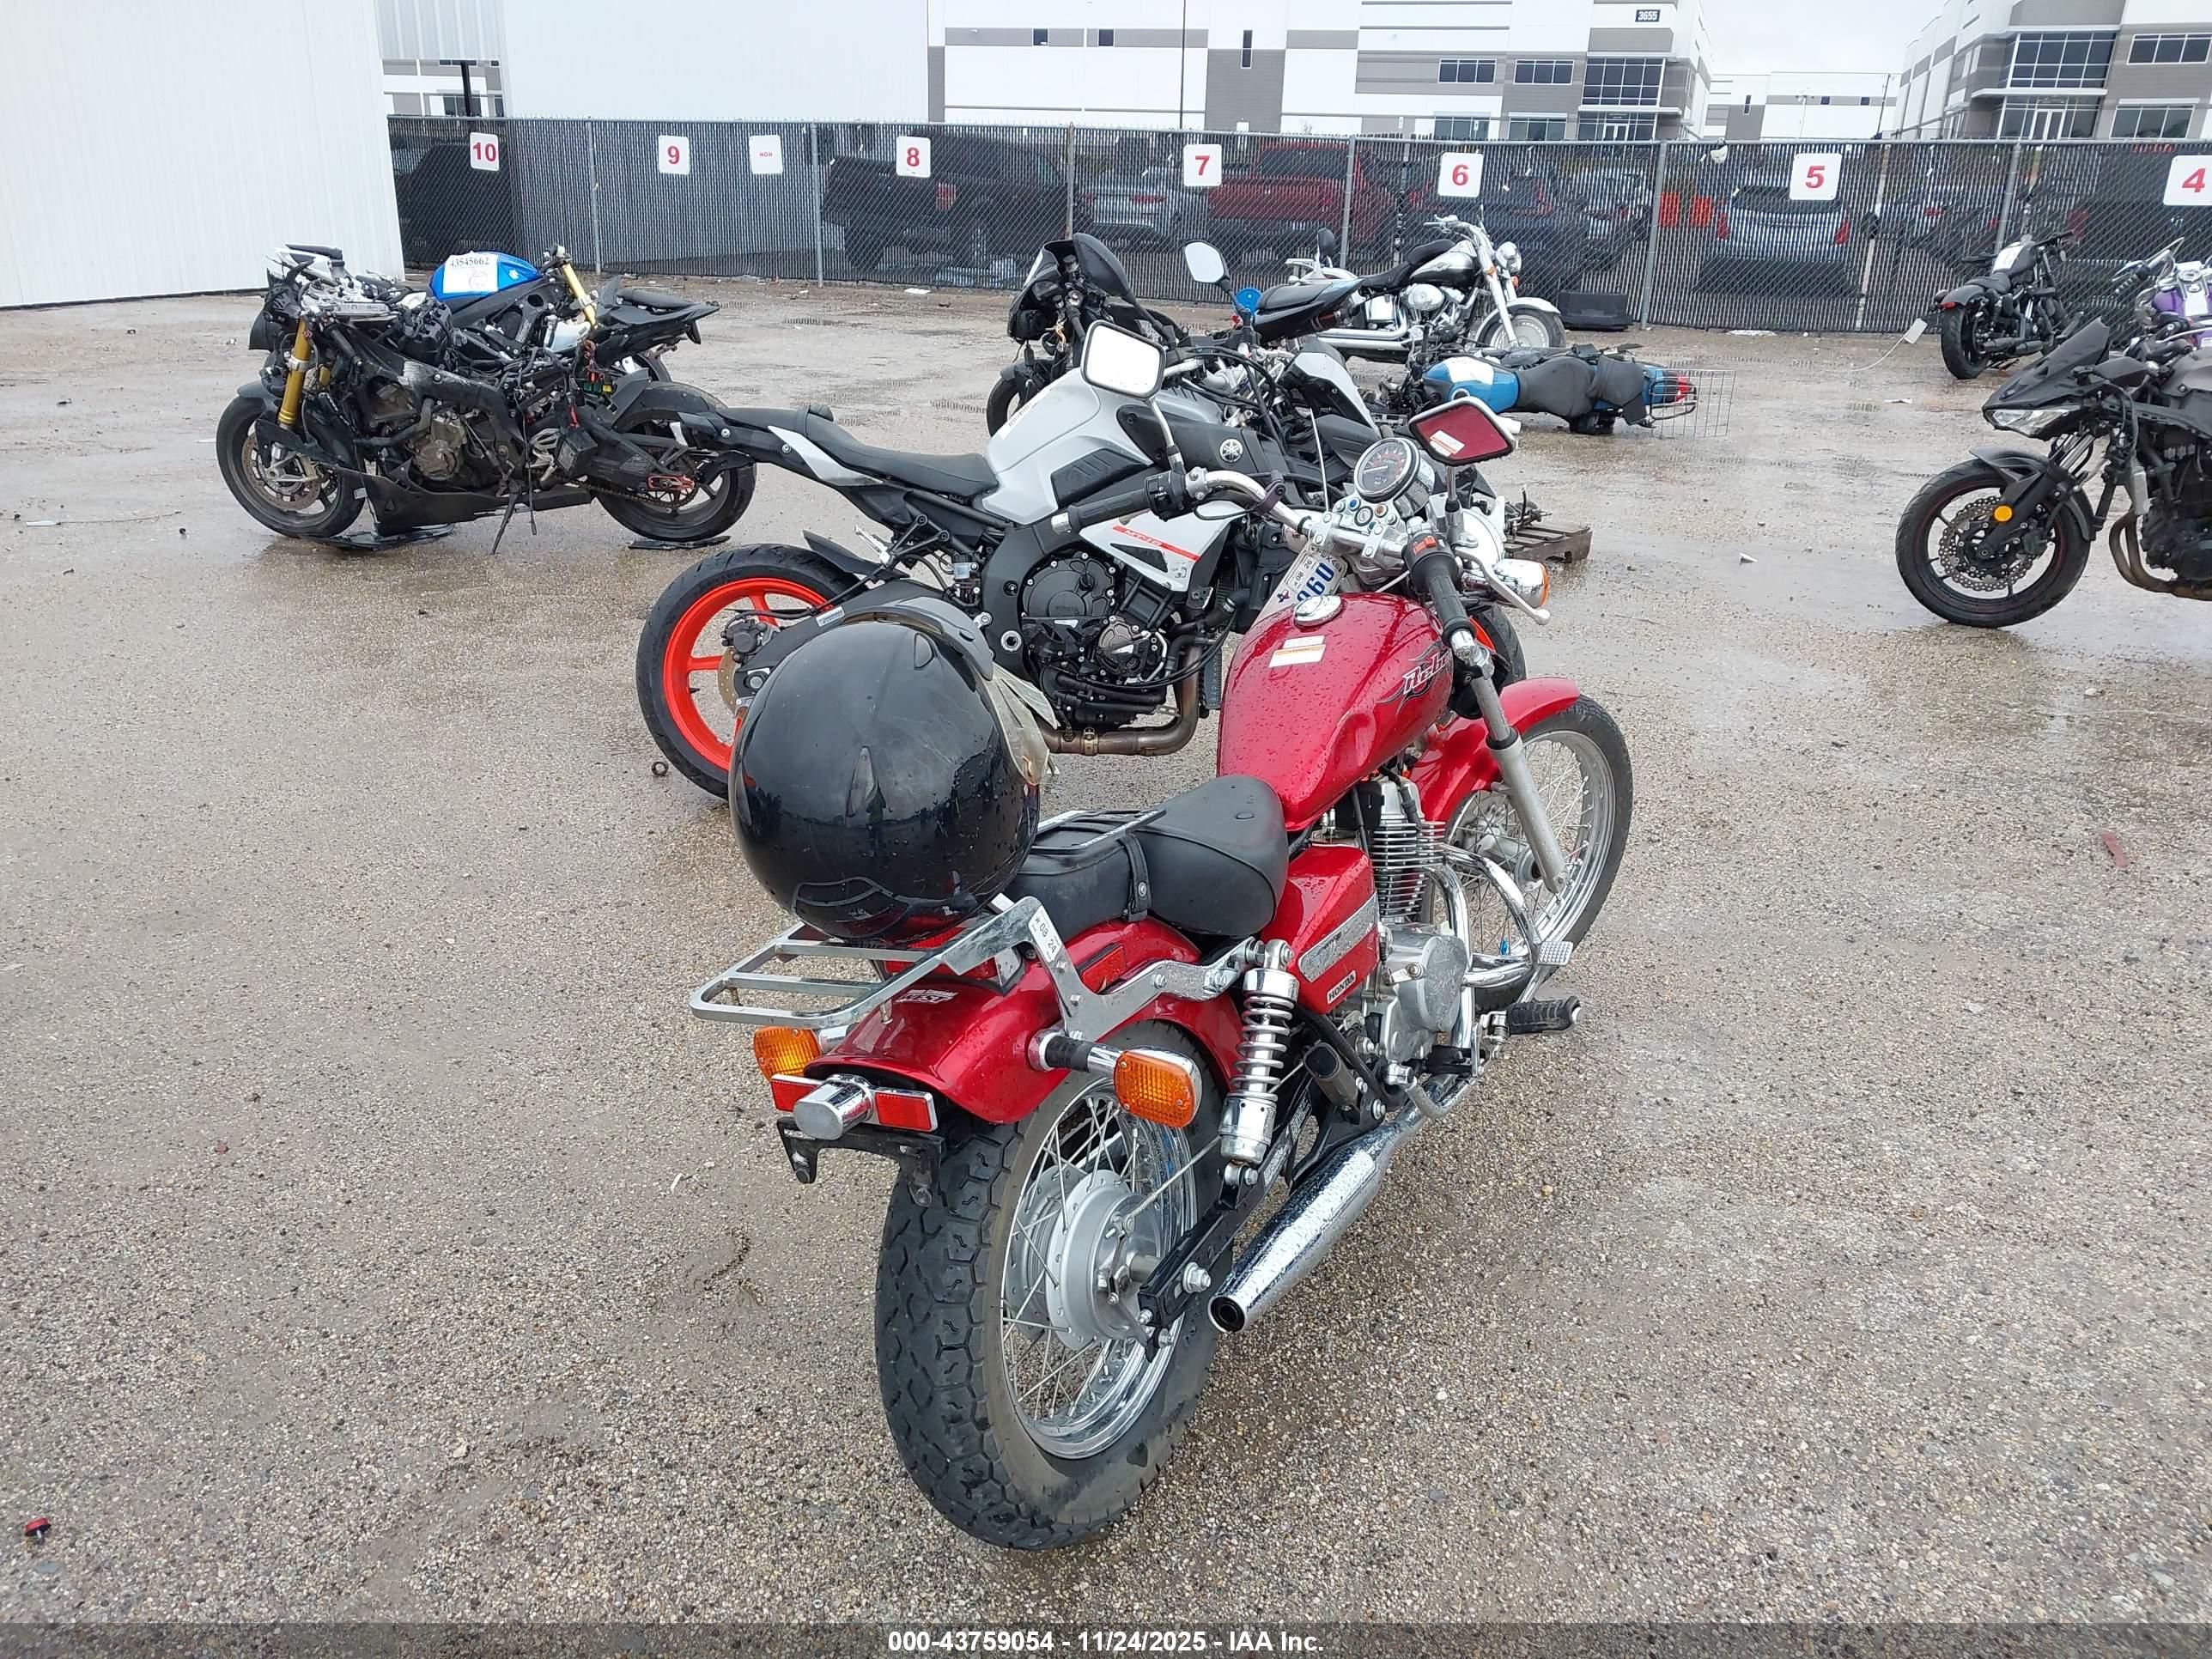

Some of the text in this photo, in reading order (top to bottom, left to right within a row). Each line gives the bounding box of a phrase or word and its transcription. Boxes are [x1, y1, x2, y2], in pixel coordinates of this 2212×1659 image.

[1638, 10, 1658, 21] 3655
[473, 143, 497, 162] 10
[668, 146, 680, 165] 9
[906, 147, 921, 167] 8
[1194, 155, 1210, 175] 7
[1451, 164, 1469, 186] 6
[1806, 165, 1825, 189] 5
[2181, 167, 2206, 193] 4
[1401, 650, 1451, 695] Rebe
[1328, 973, 1355, 1001] HONDA
